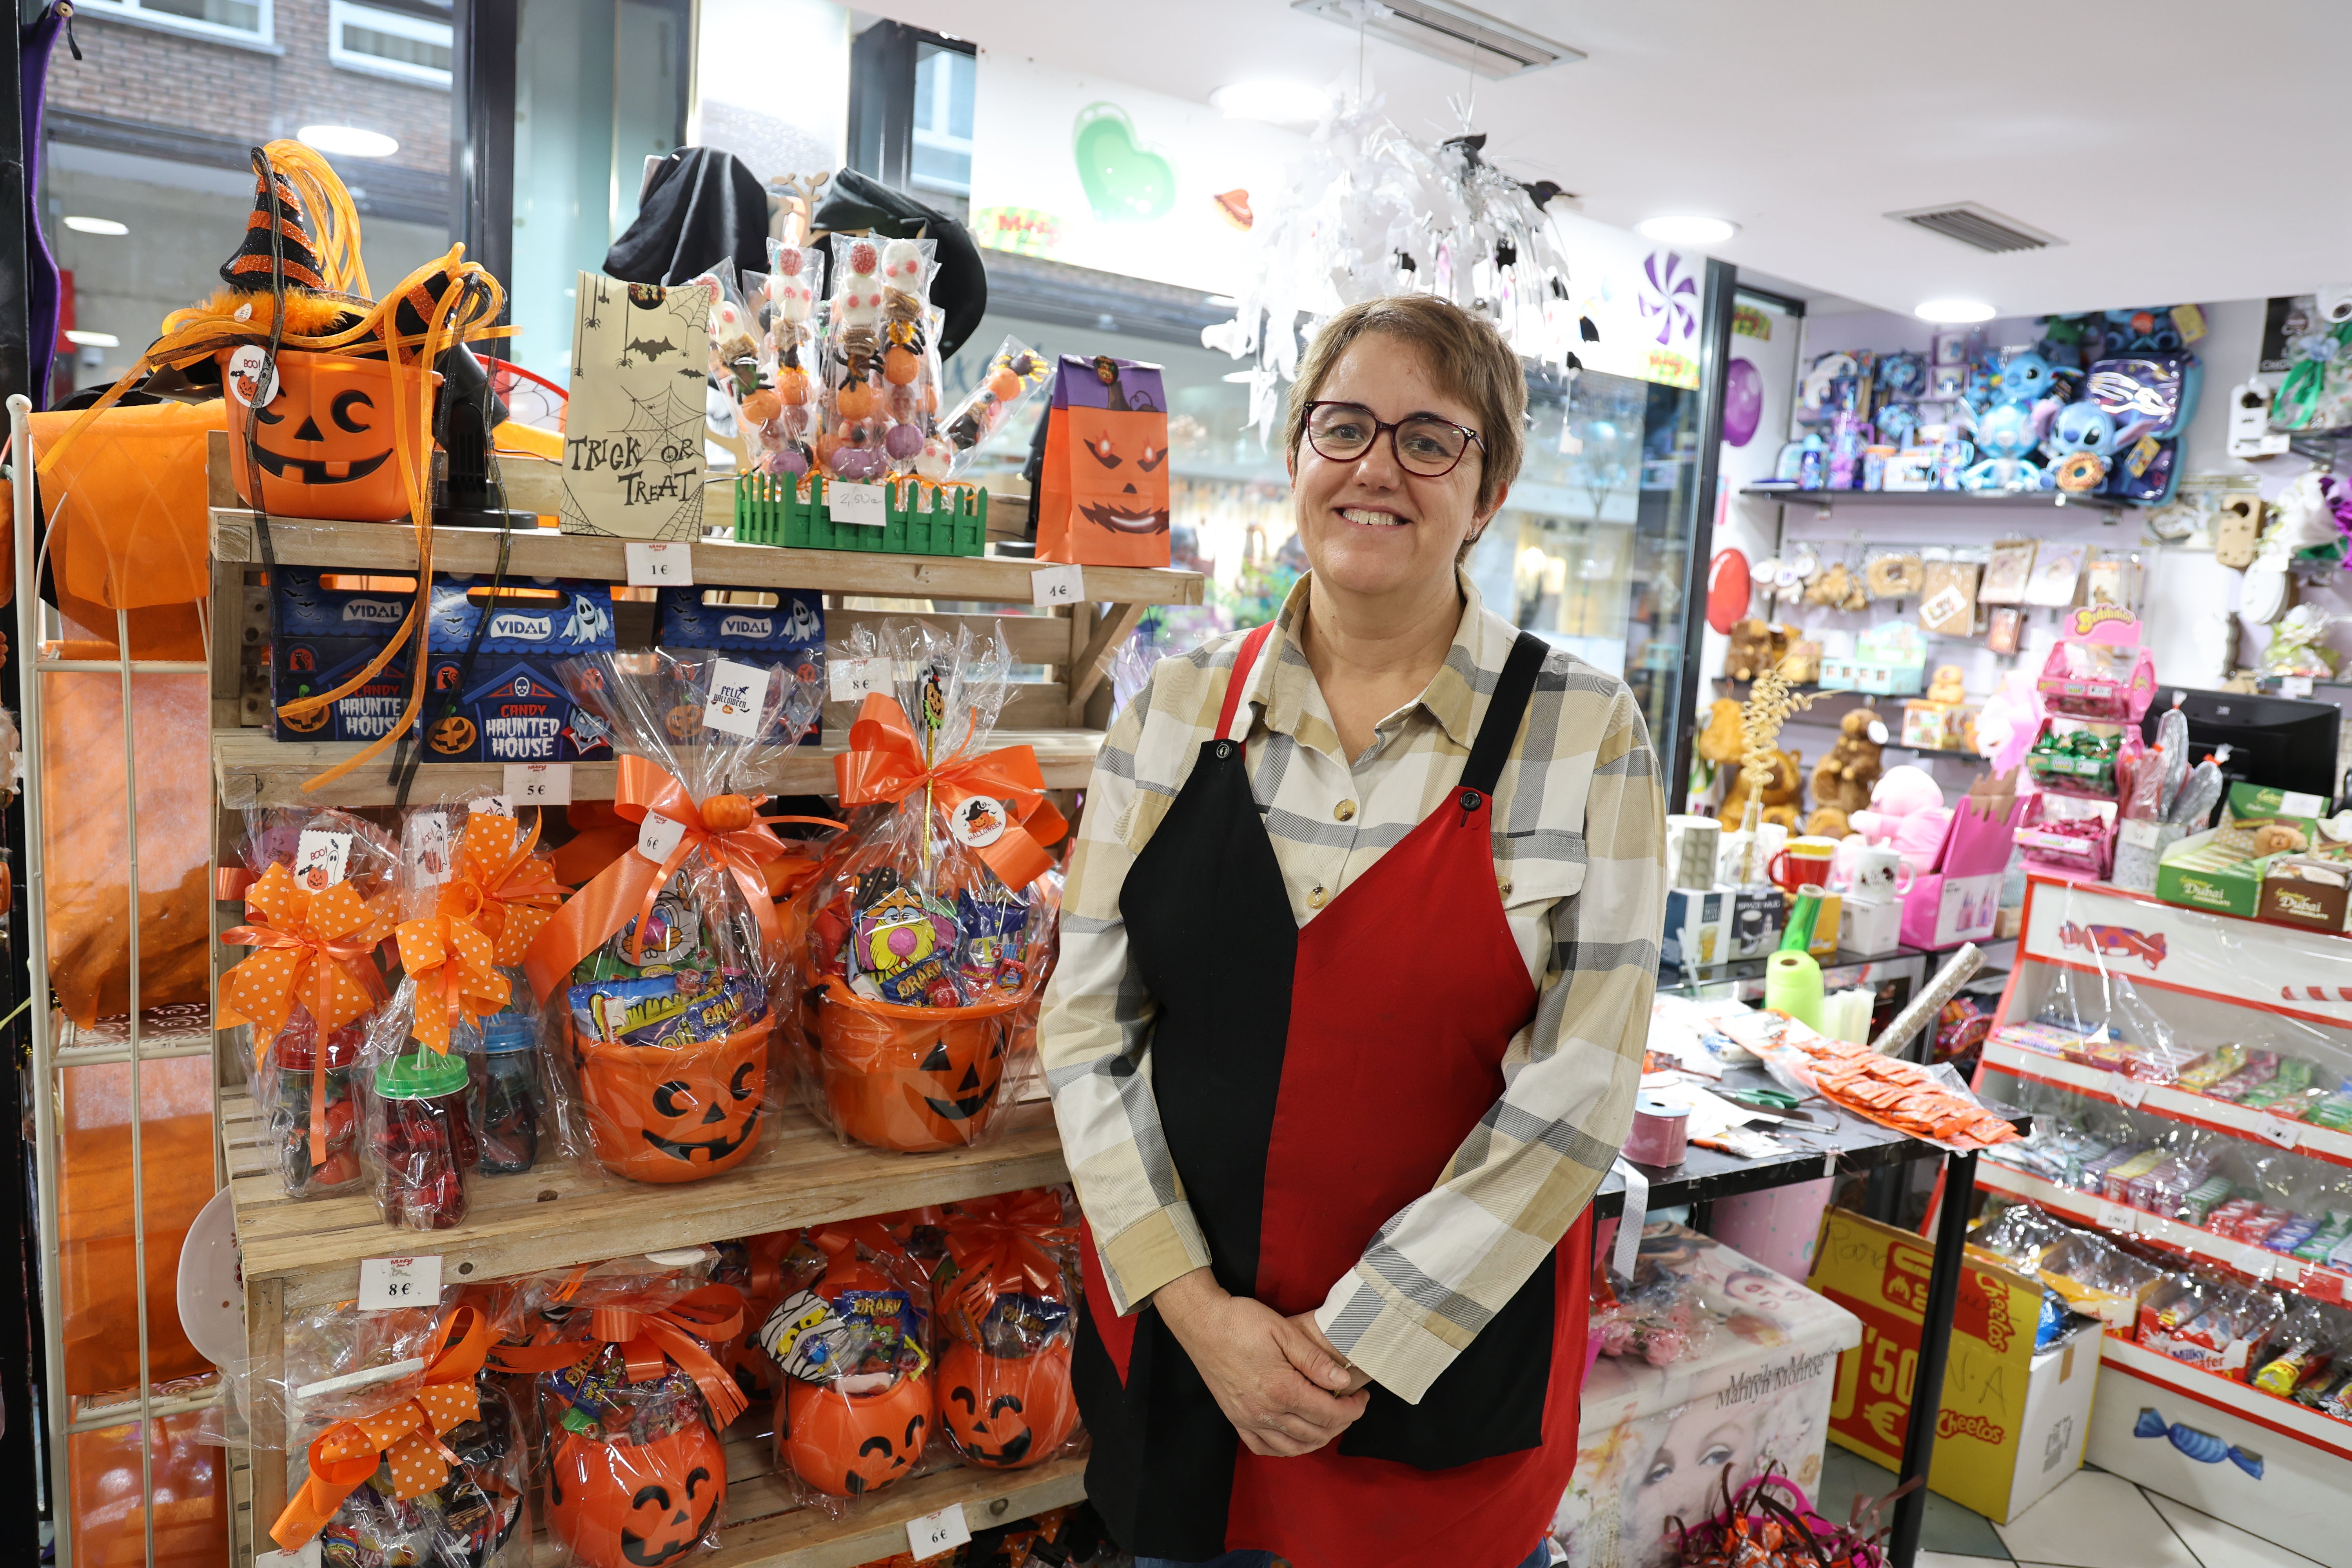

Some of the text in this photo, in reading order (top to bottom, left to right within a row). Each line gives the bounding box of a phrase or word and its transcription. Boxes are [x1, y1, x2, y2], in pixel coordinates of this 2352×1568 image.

[244, 359, 261, 371] BOO!
[567, 435, 695, 470] TRICK OR
[617, 466, 697, 506] TREAT
[652, 564, 668, 575] 1 €
[348, 604, 400, 618] VIDAL
[496, 621, 547, 635] VIDAL
[725, 621, 768, 633] VIDAL
[354, 684, 400, 696] CANDY
[852, 679, 870, 690] 8 €
[721, 686, 741, 700] FELIZ
[339, 697, 401, 716] HAUNTE
[714, 693, 746, 708] HALLOWEEN
[500, 704, 547, 717] CANDY
[345, 716, 399, 736] HOUS
[485, 717, 561, 737] HAUNTED
[492, 737, 554, 758] HOUSE
[527, 785, 545, 795] 5 €
[967, 820, 1003, 842] HALLOWEEN
[647, 837, 659, 850] 6 €
[310, 846, 328, 861] BOO!
[961, 968, 996, 980] snacks
[388, 1283, 410, 1296] 8 €
[1976, 1272, 2016, 1352] Cheetos
[2172, 1348, 2206, 1360] Milky
[1715, 1359, 1824, 1410] Marilyn Monroe
[1937, 1412, 2004, 1443] Cheetos
[932, 1529, 948, 1543] 6 €
